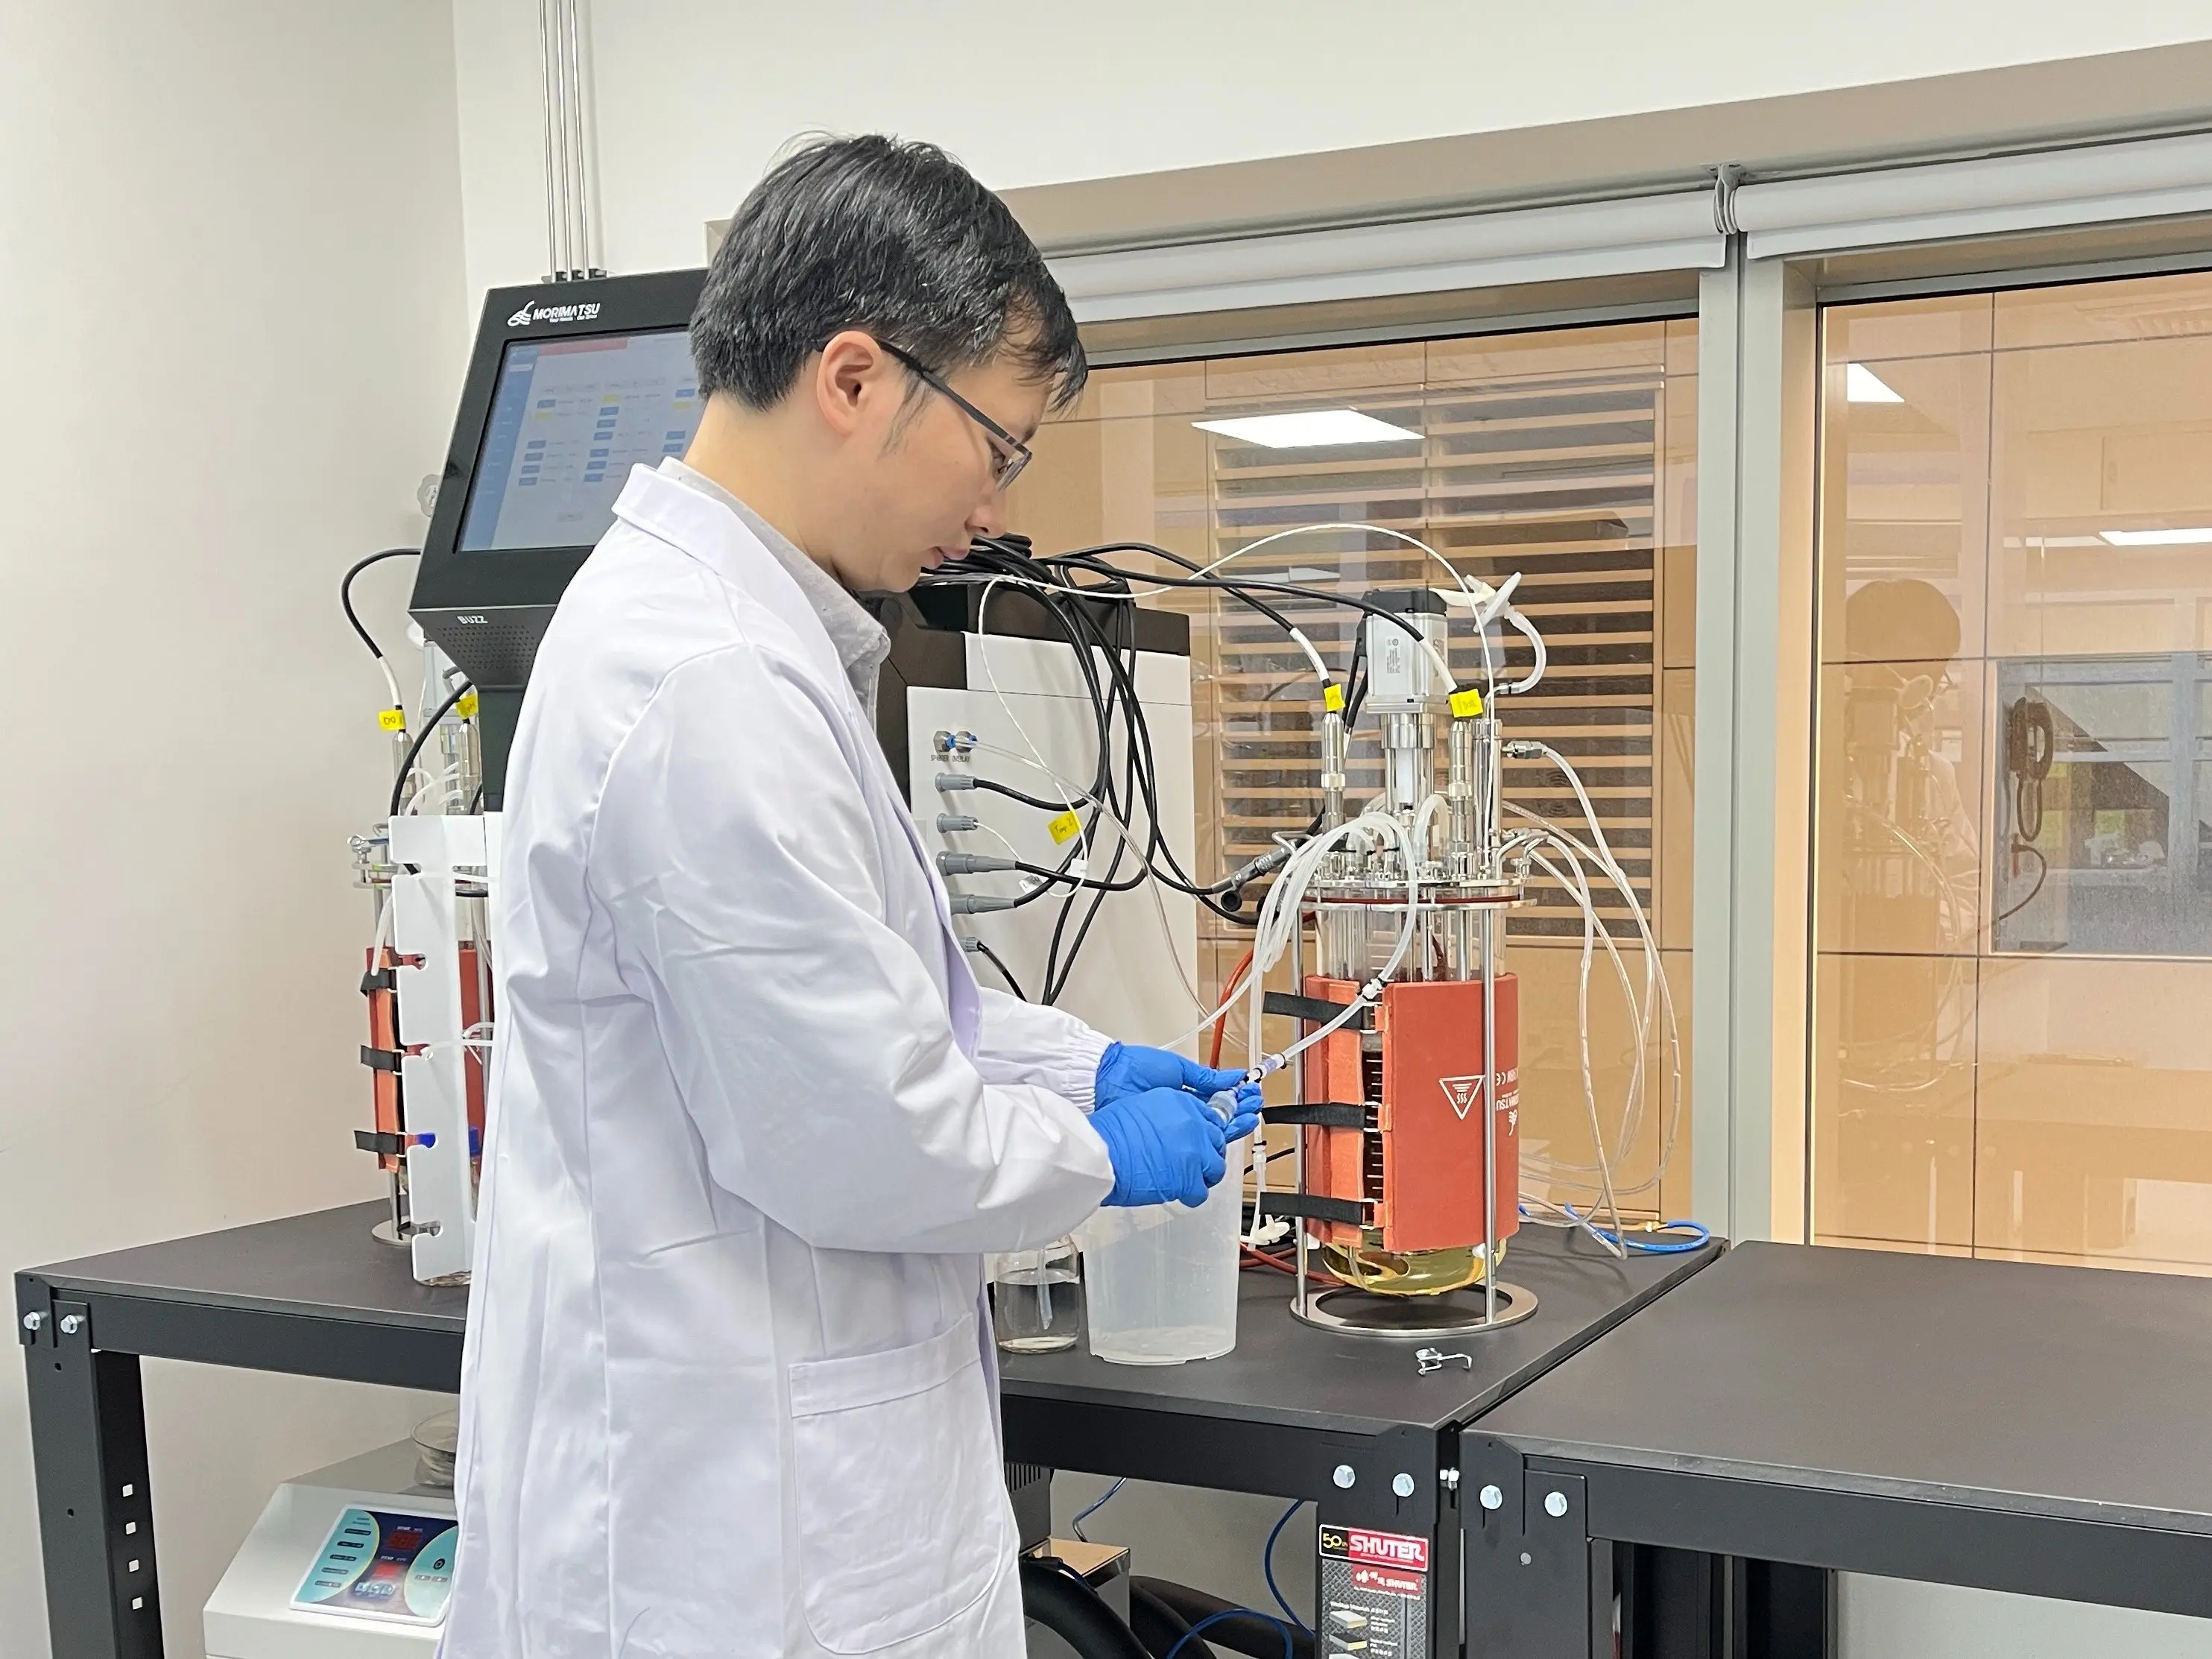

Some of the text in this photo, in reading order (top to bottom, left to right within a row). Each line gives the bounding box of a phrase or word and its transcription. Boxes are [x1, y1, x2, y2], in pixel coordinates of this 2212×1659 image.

[532, 303, 601, 320] MORIMATSU
[457, 615, 489, 624] BUZZ
[1349, 1535, 1425, 1562] SHUTER
[1385, 1578, 1418, 1591] SHUTER
